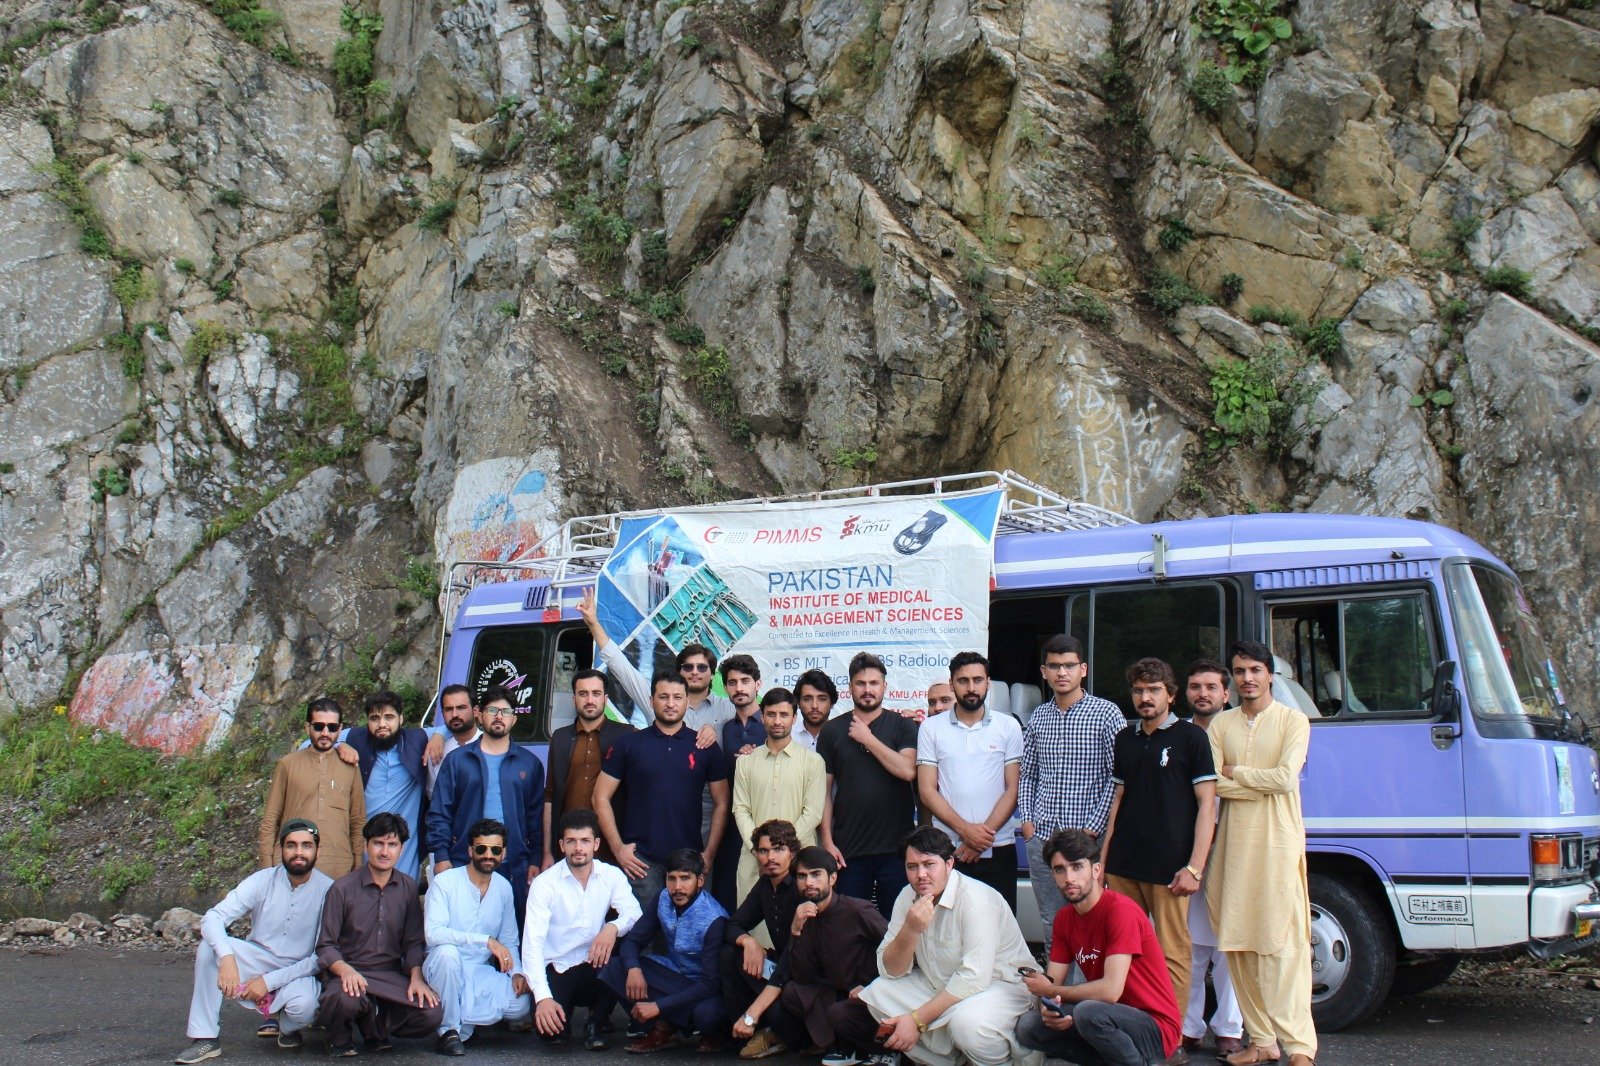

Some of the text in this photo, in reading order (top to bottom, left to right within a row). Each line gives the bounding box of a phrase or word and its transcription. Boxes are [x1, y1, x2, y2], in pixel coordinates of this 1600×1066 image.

[753, 526, 823, 544] PIMMS
[854, 523, 890, 535] kmu
[768, 564, 893, 593] PAKISTAN
[769, 589, 933, 610] INSTITUTE OF MEDICAL
[769, 607, 964, 628] & MANAGEMENT SCIENCES
[768, 630, 804, 639] Committed
[805, 630, 813, 638] to
[814, 628, 850, 638] Excellence
[859, 627, 881, 636] Health
[881, 627, 888, 635] &
[889, 627, 937, 637] Management
[938, 625, 970, 634] Sciences
[783, 656, 831, 670] BS MLT
[877, 653, 949, 667] BS Radiolo
[783, 674, 799, 687] BS
[889, 690, 909, 699] KMU
[1409, 915, 1469, 923] Performance
